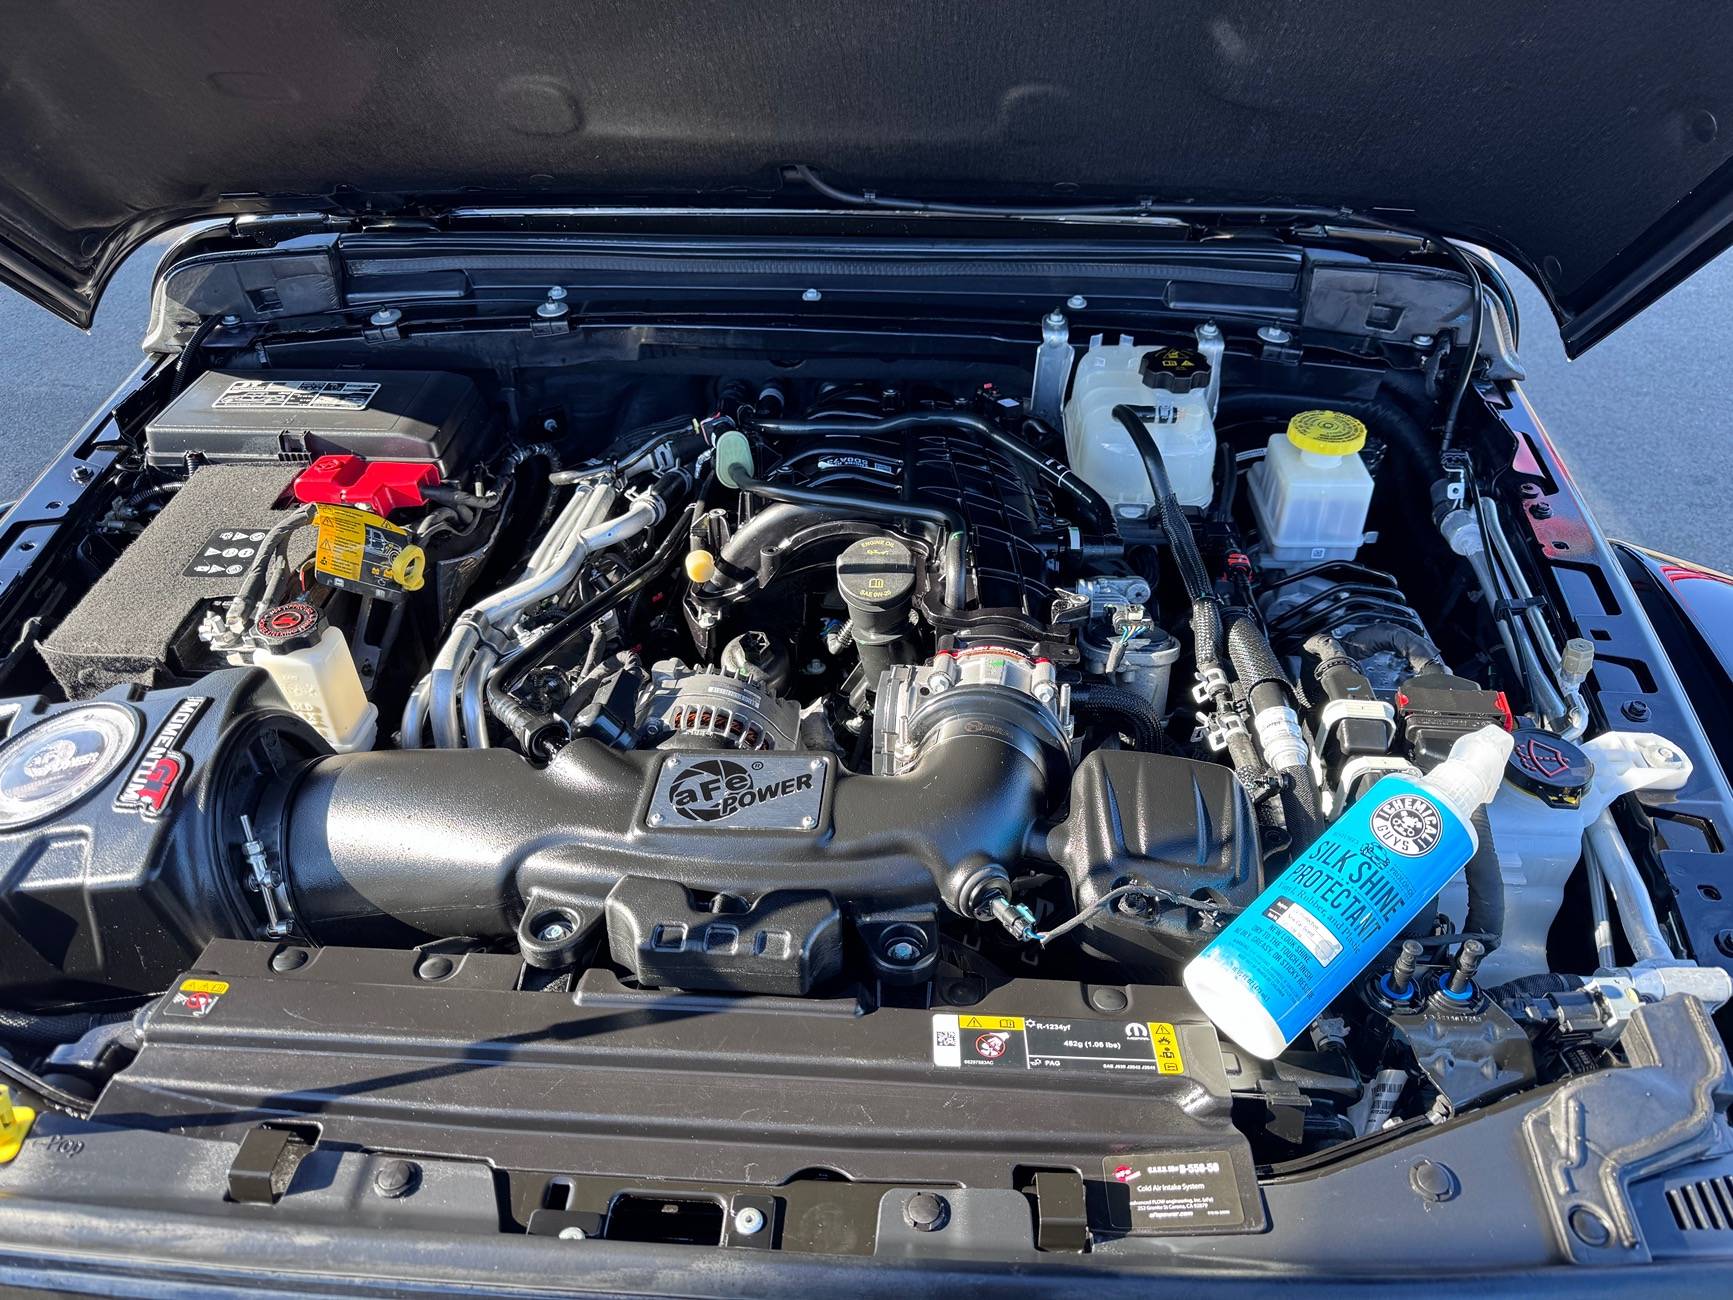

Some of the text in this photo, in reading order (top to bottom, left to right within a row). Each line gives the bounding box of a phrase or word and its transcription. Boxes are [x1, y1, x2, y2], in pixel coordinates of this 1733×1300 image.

[861, 540, 884, 548] ENGINE
[118, 699, 204, 802] MOMENTUM
[138, 757, 180, 809] GT
[674, 772, 814, 816] aFe POWER
[1376, 823, 1409, 851] GUYS
[1381, 797, 1437, 843] CHEMICAL
[1308, 840, 1405, 922] SILK SHINE
[1285, 862, 1382, 943] PROTECTANT
[1296, 890, 1326, 918] Rubber,
[1326, 914, 1342, 930] and
[1268, 922, 1283, 937] NEW
[1280, 933, 1296, 948] LOOK
[1269, 936, 1281, 949] THE
[1279, 945, 1299, 964] TOUCH
[1295, 961, 1314, 980] FINISH
[1278, 958, 1300, 979] STICKY
[1036, 1023, 1071, 1032] R-1234yf
[1137, 1182, 1205, 1192] Cold Air Intake System
